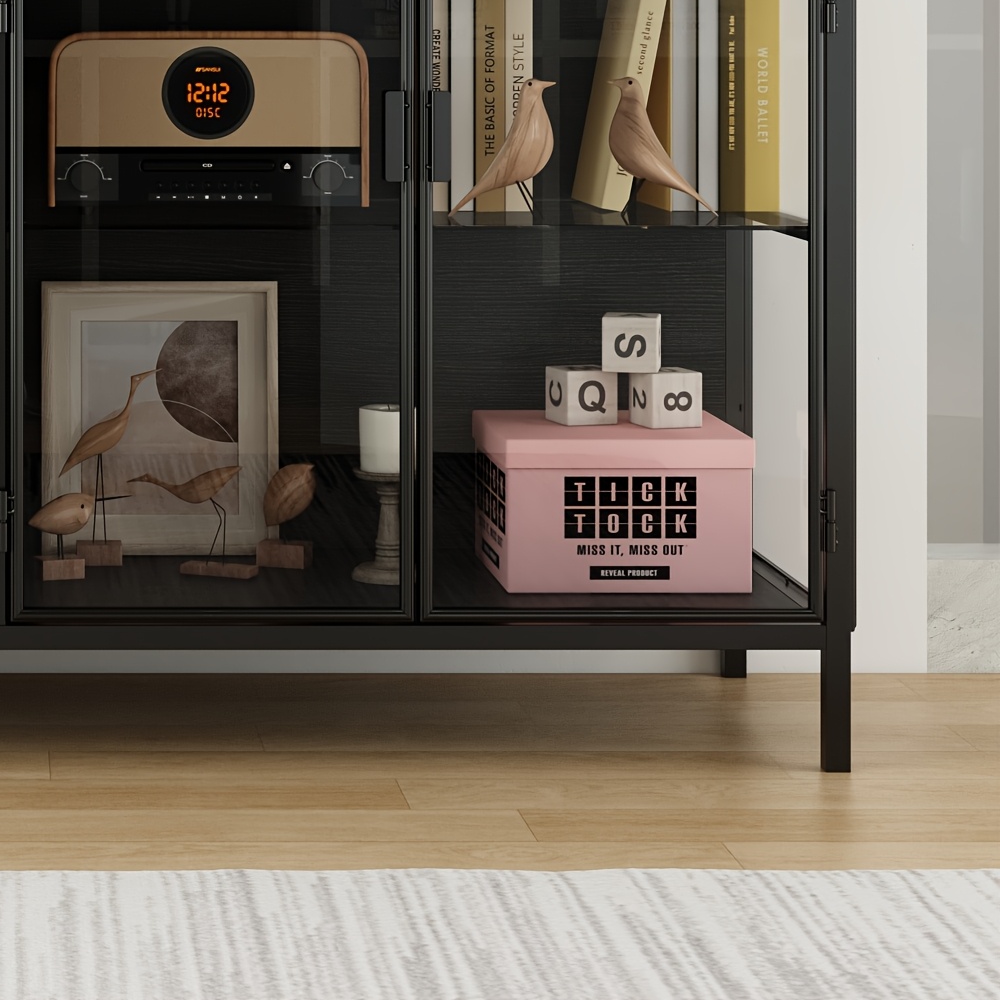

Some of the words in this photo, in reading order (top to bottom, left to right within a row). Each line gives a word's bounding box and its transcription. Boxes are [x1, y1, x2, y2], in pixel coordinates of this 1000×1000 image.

[641, 10, 654, 40] glance
[432, 29, 441, 60] CREATE
[484, 24, 496, 73] FORMAT
[512, 33, 525, 71] STYLE
[637, 43, 648, 74] second
[757, 47, 769, 93] WORLD
[187, 82, 230, 103] 12:12
[484, 78, 496, 94] OF
[484, 97, 496, 131] BASIC
[757, 100, 769, 144] BALLET
[485, 135, 496, 157] THE
[614, 332, 647, 358] S
[578, 380, 606, 414] Q
[663, 390, 693, 412] 8
[572, 480, 689, 503] TICK
[572, 512, 689, 535] TOCK
[576, 544, 606, 556] MISS
[610, 544, 624, 557] IT,
[629, 544, 658, 556] MISS
[662, 544, 684, 556] OUT
[600, 569, 626, 577] REVEAL
[627, 569, 658, 577] PRODUCT
